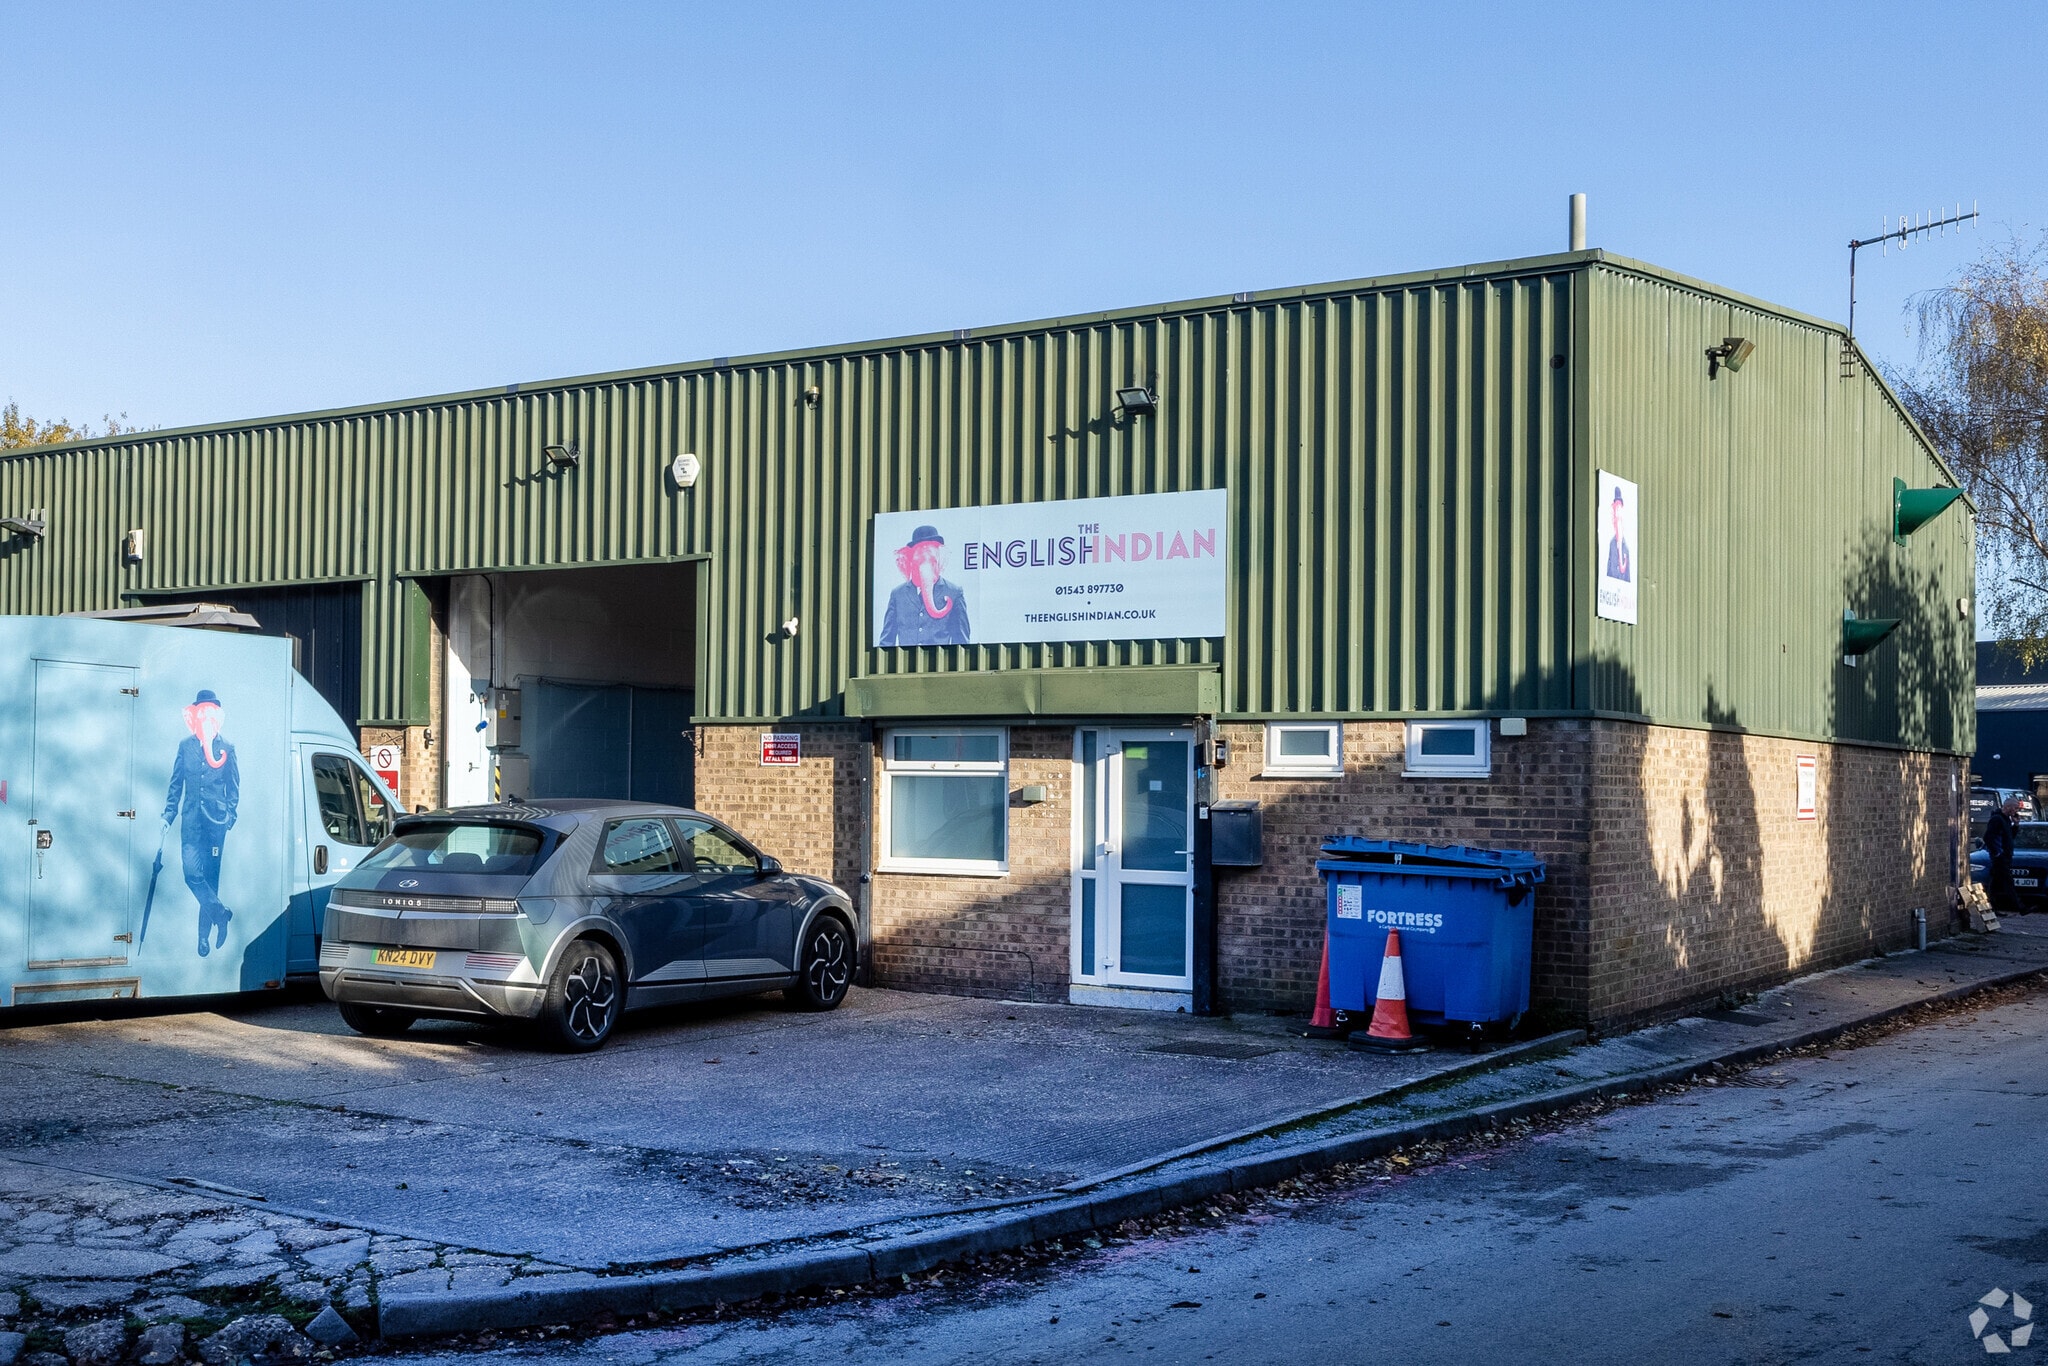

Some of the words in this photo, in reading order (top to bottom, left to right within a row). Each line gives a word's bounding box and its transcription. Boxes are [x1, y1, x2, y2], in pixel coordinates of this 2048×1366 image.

[1078, 523, 1100, 534] THE
[1055, 585, 1085, 596] 01543
[1087, 583, 1124, 595] 897730
[1024, 609, 1156, 623] THEENGLISHINDIAN.CO.UK
[1367, 909, 1443, 927] FORTRESS
[377, 949, 407, 963] KN24
[409, 951, 434, 966] DVY
